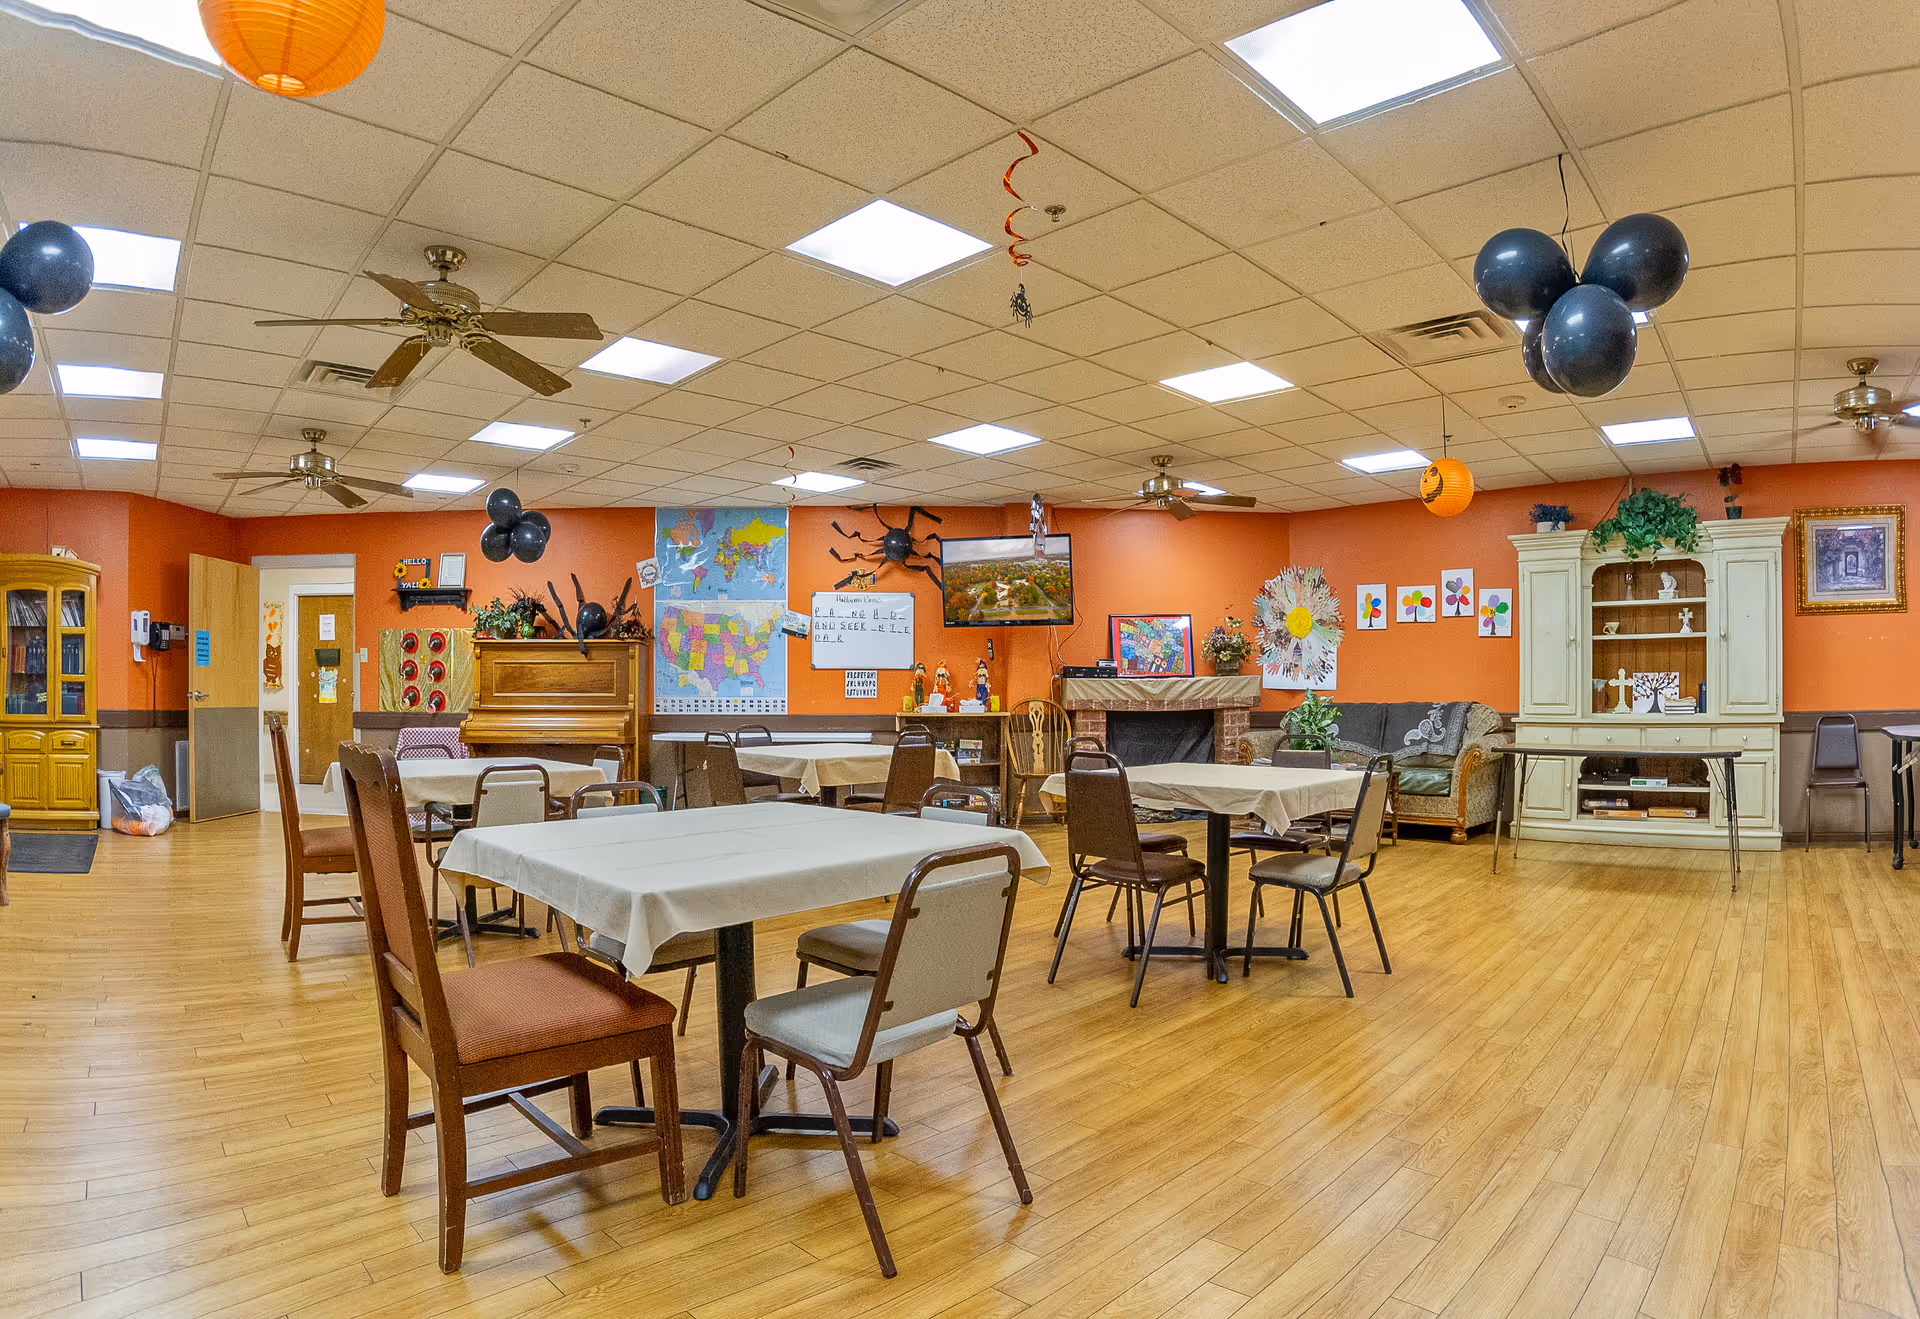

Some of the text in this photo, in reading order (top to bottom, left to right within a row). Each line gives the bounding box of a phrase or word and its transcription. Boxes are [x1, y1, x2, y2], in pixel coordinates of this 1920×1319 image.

[403, 557, 427, 565] HELLO
[815, 621, 836, 630] AND
[840, 621, 867, 631] SEEK
